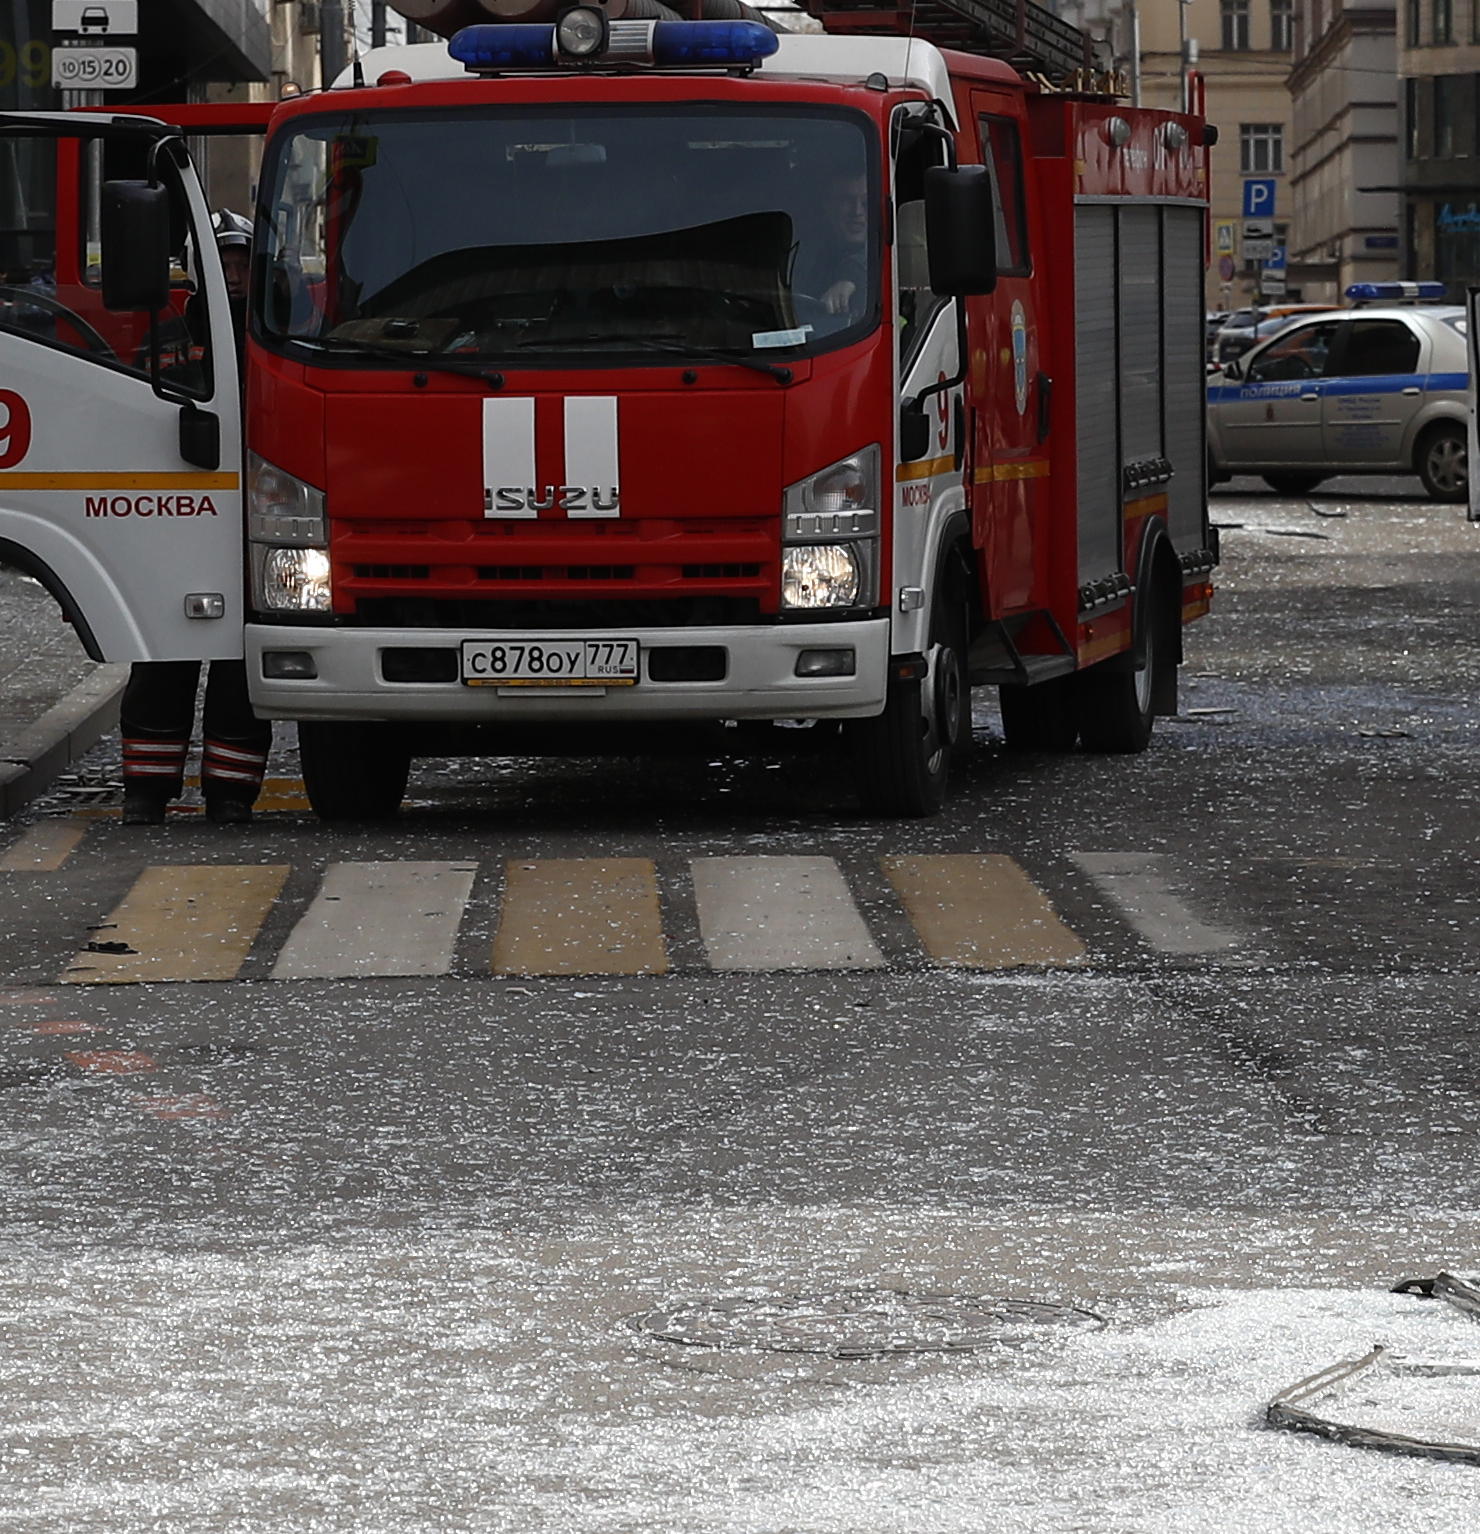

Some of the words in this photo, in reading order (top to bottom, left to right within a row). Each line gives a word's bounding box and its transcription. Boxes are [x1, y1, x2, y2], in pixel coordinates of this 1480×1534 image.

[62, 62, 76, 74] 10
[81, 60, 96, 75] 15
[103, 59, 127, 76] 20
[1251, 184, 1268, 213] P
[937, 370, 949, 451] 9
[85, 496, 218, 517] МОСКВА
[484, 485, 620, 510] ISUZU
[587, 644, 630, 665] 777
[597, 666, 619, 674] RUS
